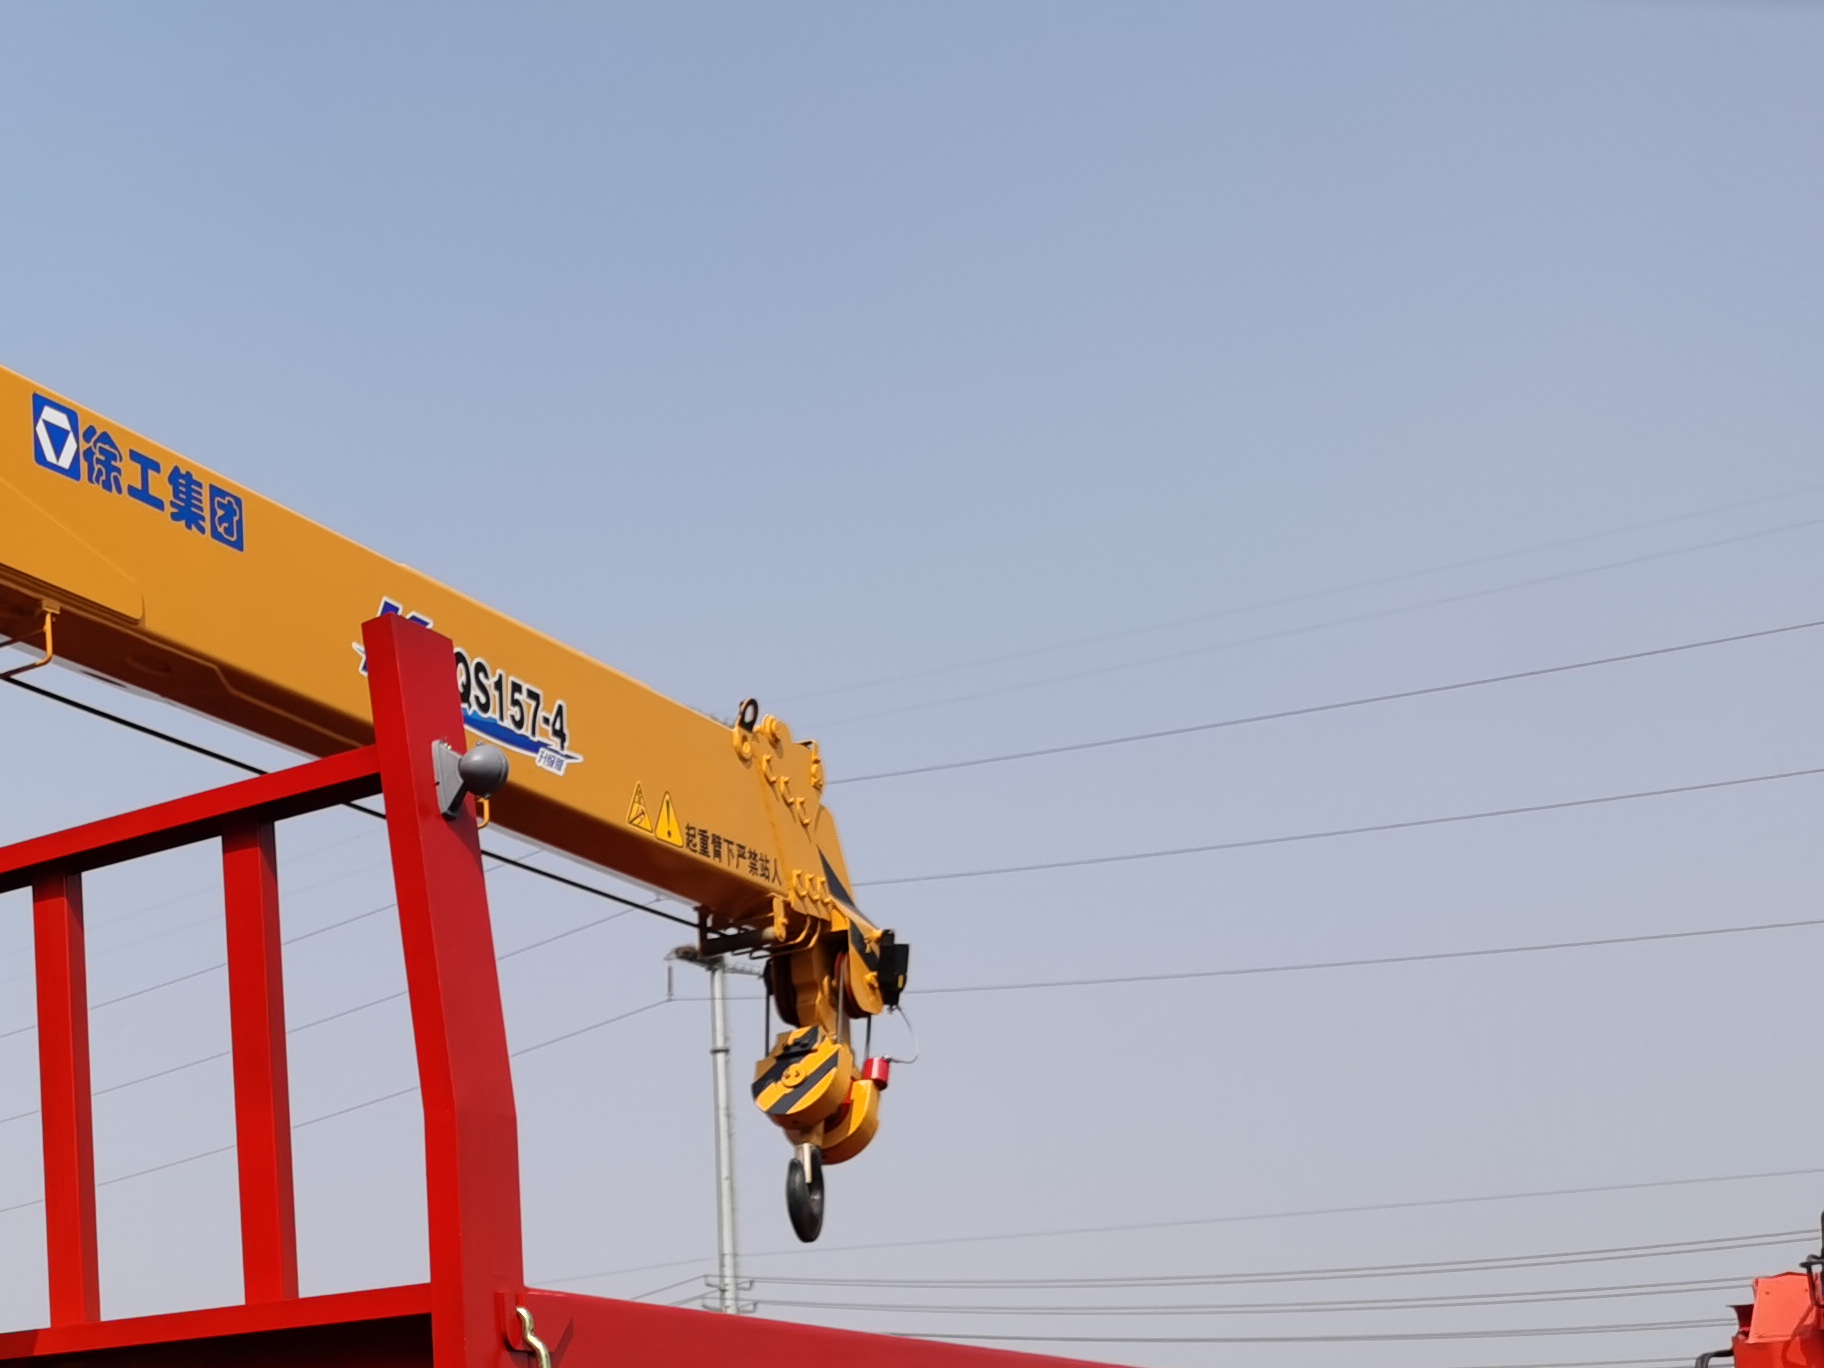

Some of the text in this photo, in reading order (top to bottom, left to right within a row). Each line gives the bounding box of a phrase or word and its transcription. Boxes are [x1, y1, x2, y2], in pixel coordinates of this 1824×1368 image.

[81, 424, 245, 553] 徐工集团
[684, 822, 783, 887] 起重臂下严禁站人
